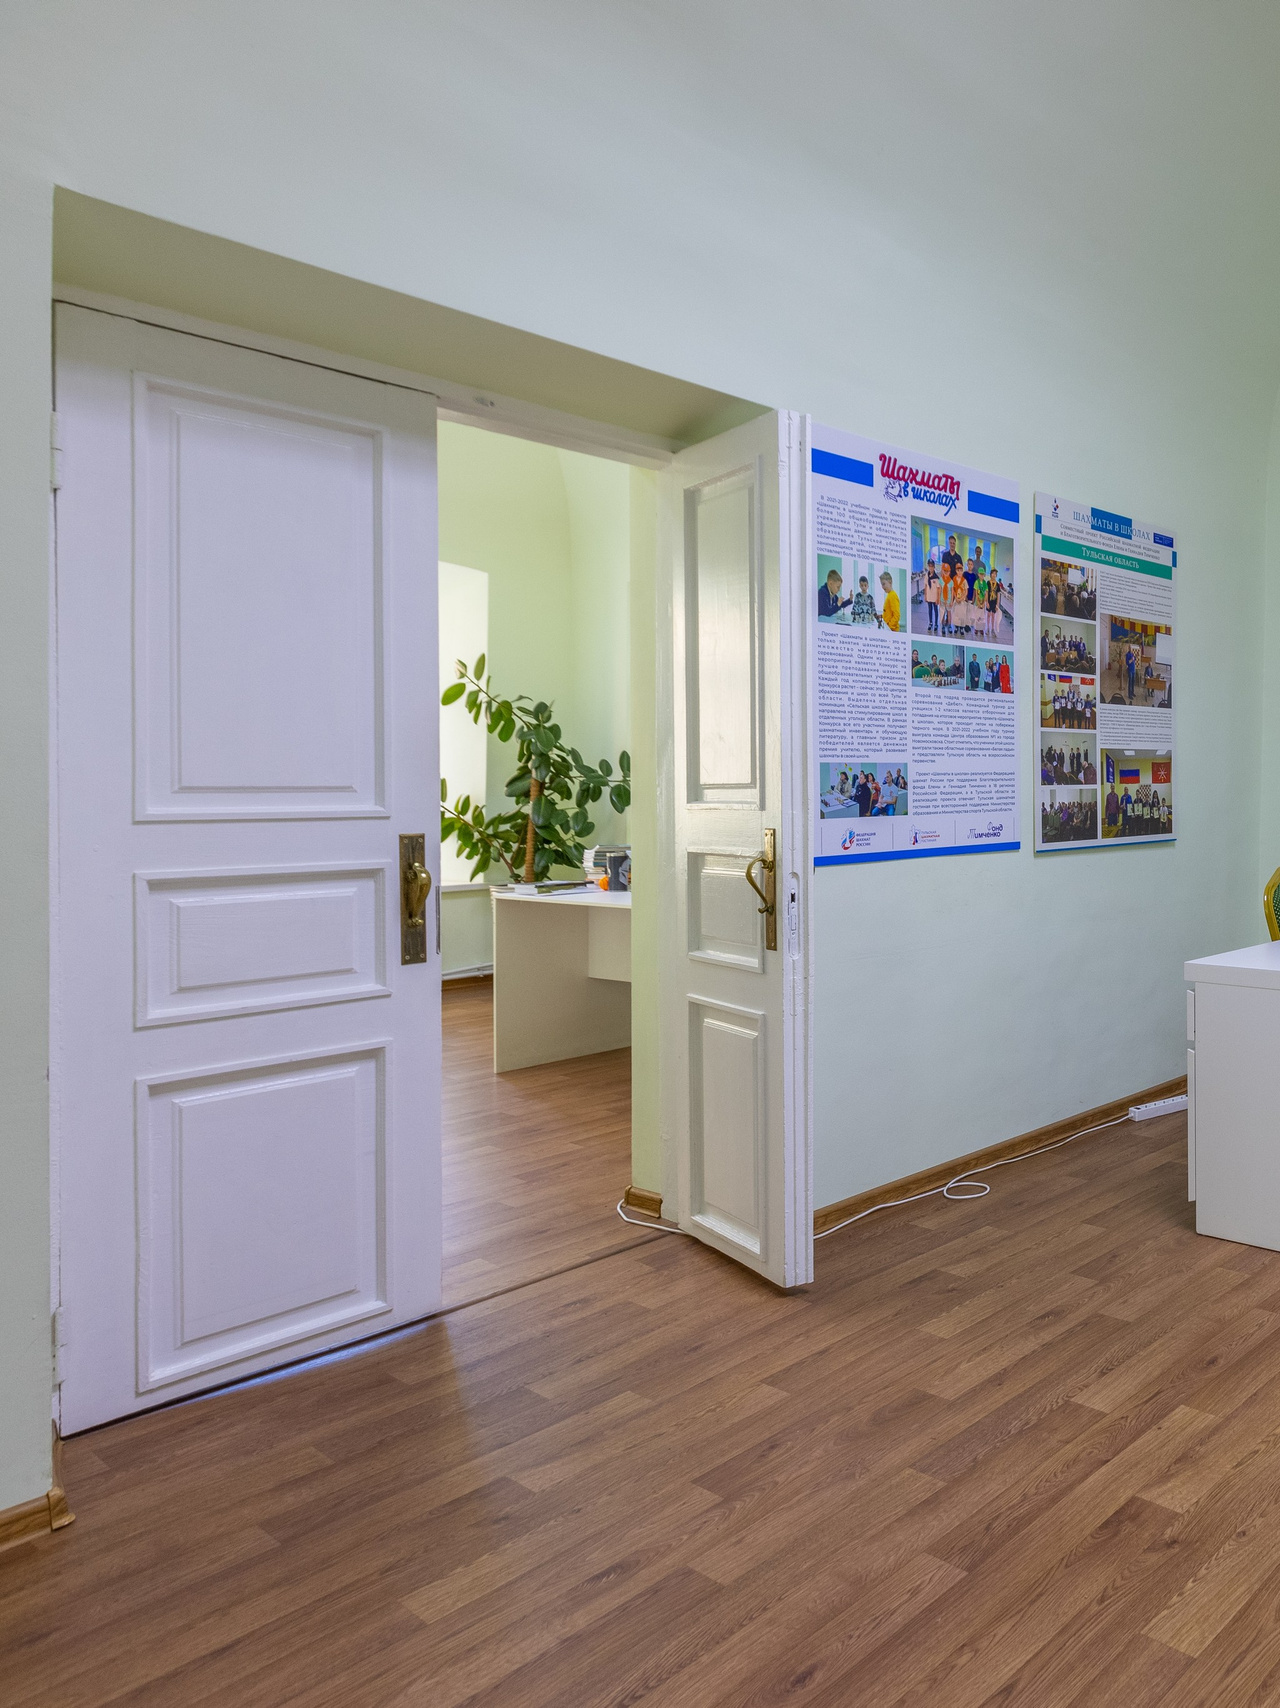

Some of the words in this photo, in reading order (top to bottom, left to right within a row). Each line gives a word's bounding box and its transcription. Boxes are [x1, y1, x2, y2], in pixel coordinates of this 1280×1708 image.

[879, 453, 960, 501] Шахматы
[902, 481, 909, 497] в
[911, 486, 957, 516] школах
[1073, 511, 1113, 531] ШАХМАТЫ
[1114, 522, 1120, 533] В
[1120, 524, 1151, 541] ШКОЛАХ
